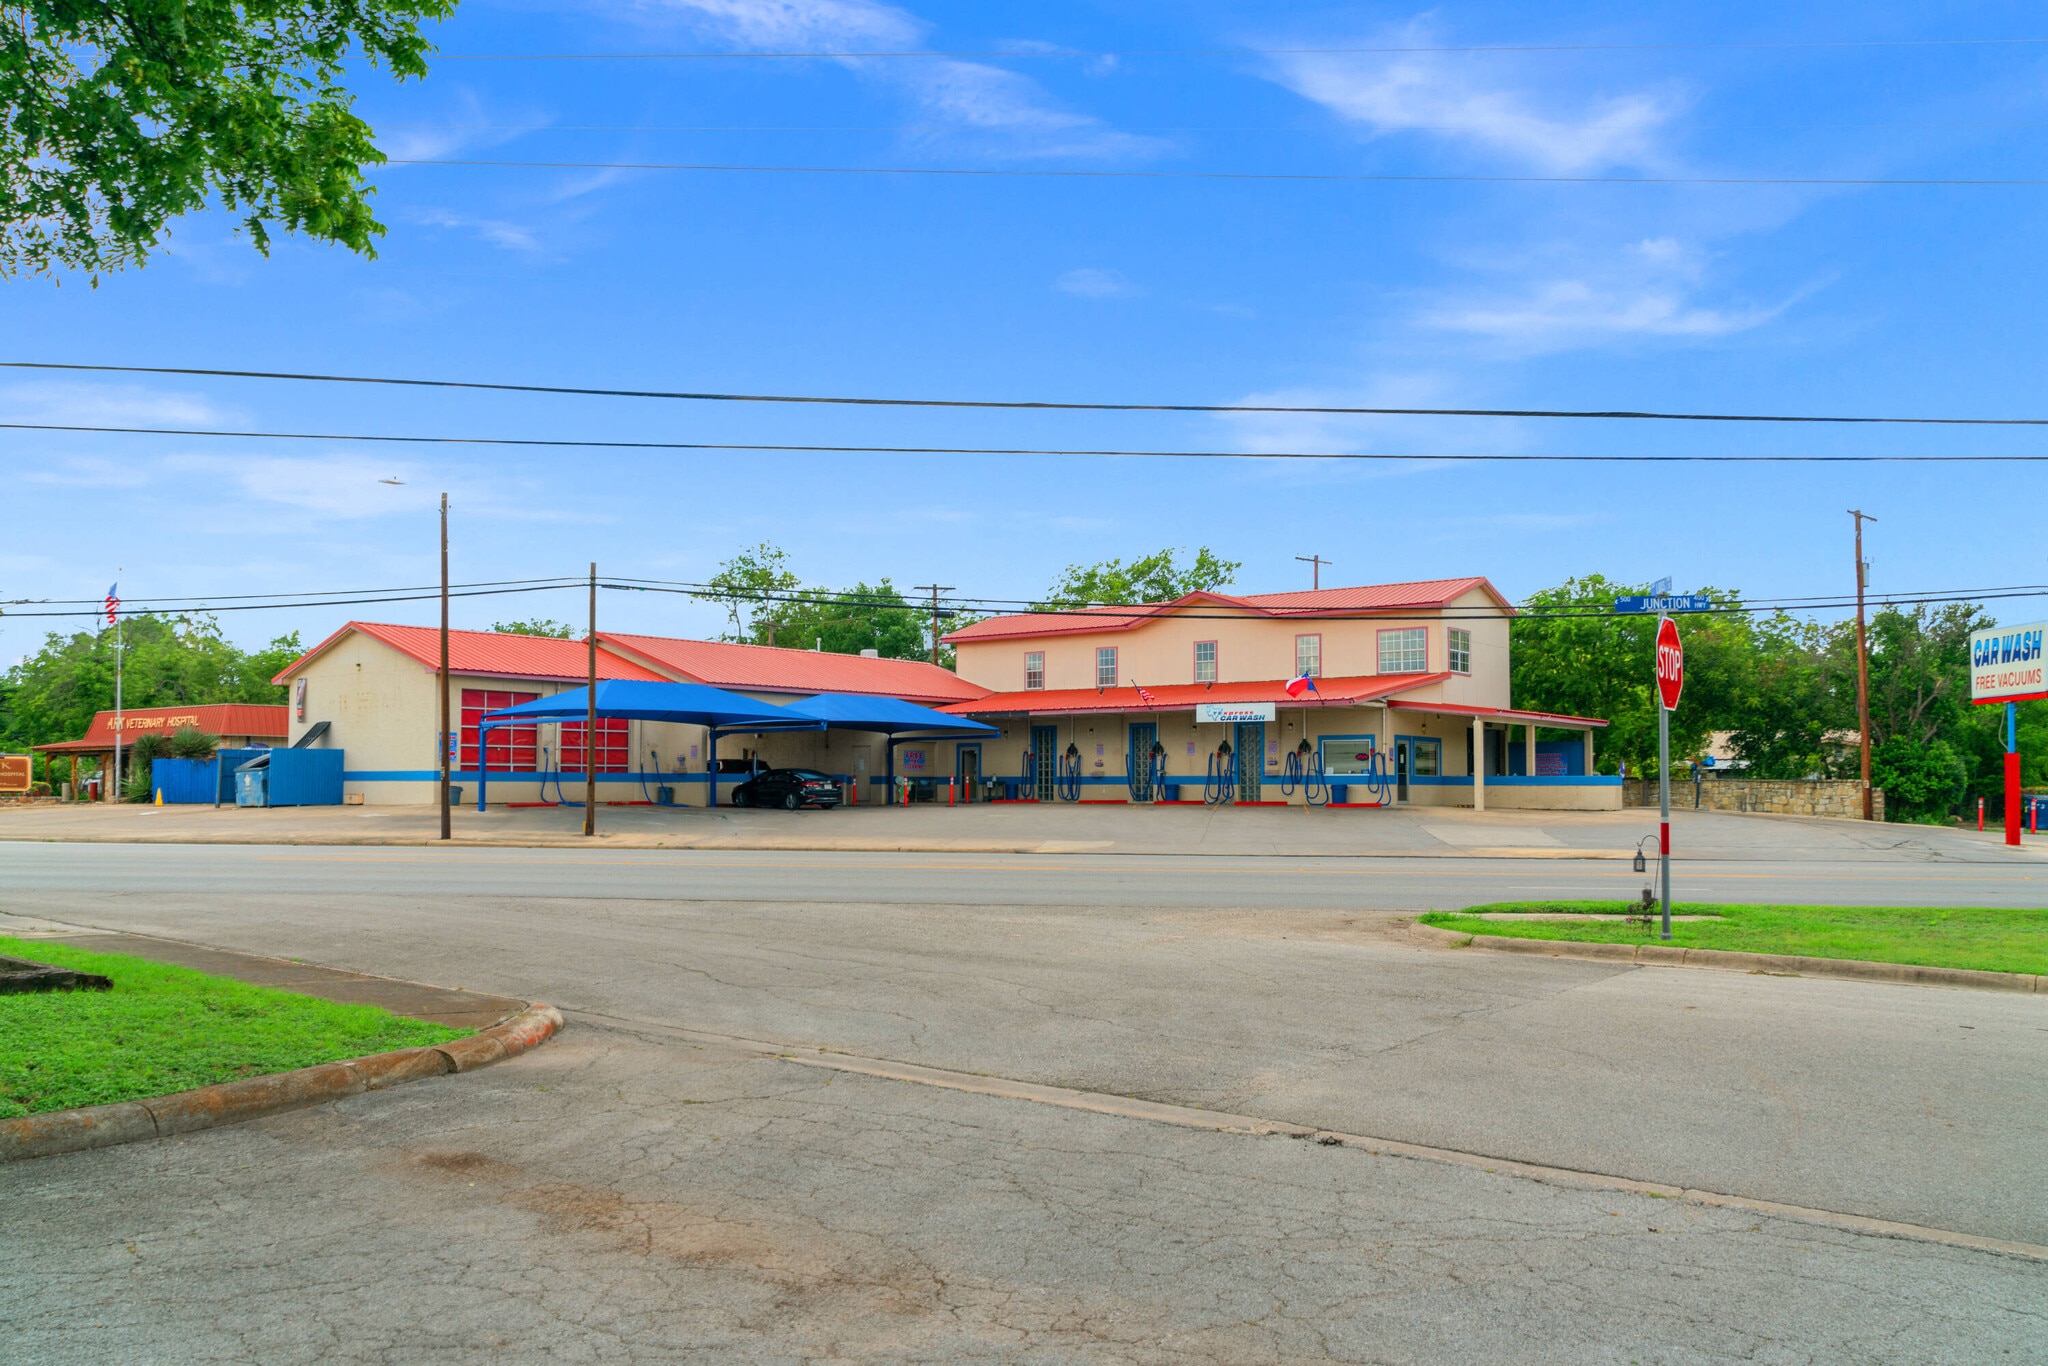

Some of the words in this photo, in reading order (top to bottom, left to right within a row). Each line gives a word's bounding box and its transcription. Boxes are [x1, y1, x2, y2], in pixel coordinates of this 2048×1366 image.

[1640, 597, 1691, 610] JUNCTION
[1974, 637, 1999, 668] CAR
[2001, 630, 2043, 664] WASH
[1658, 644, 1681, 682] STOP
[1975, 674, 1996, 690] FREE
[1997, 668, 2042, 688] VACUUMS
[166, 715, 200, 727] HOSPITAL
